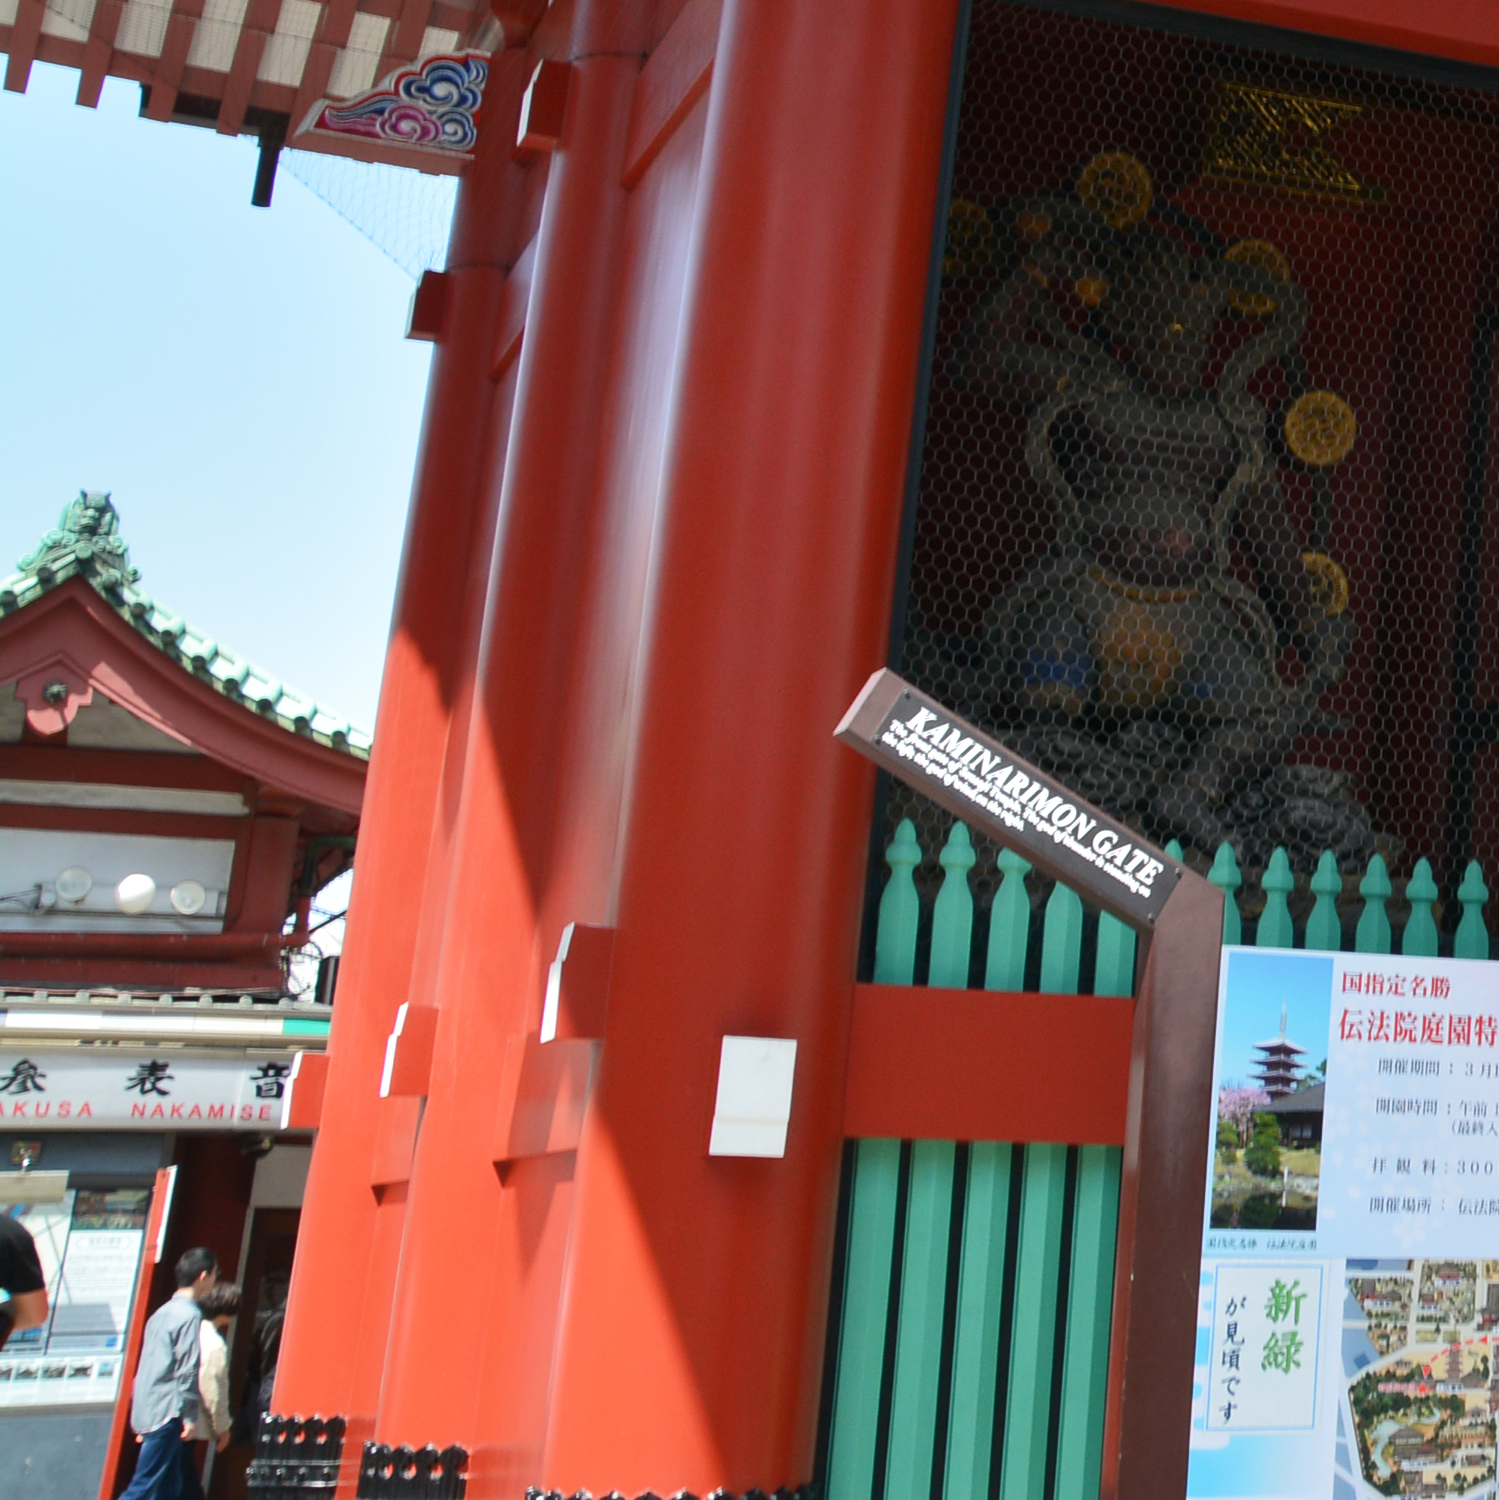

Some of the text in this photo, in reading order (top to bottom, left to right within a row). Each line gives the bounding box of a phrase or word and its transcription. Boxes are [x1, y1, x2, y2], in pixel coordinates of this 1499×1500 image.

[887, 720, 907, 742] The
[906, 707, 1163, 885] KAMINARIMON GATE
[1341, 972, 1451, 998] 国指定名勝
[131, 1102, 272, 1121] NAKAMISE
[1261, 1279, 1307, 1374] 新緑
[1219, 1296, 1246, 1425] が見頃です
